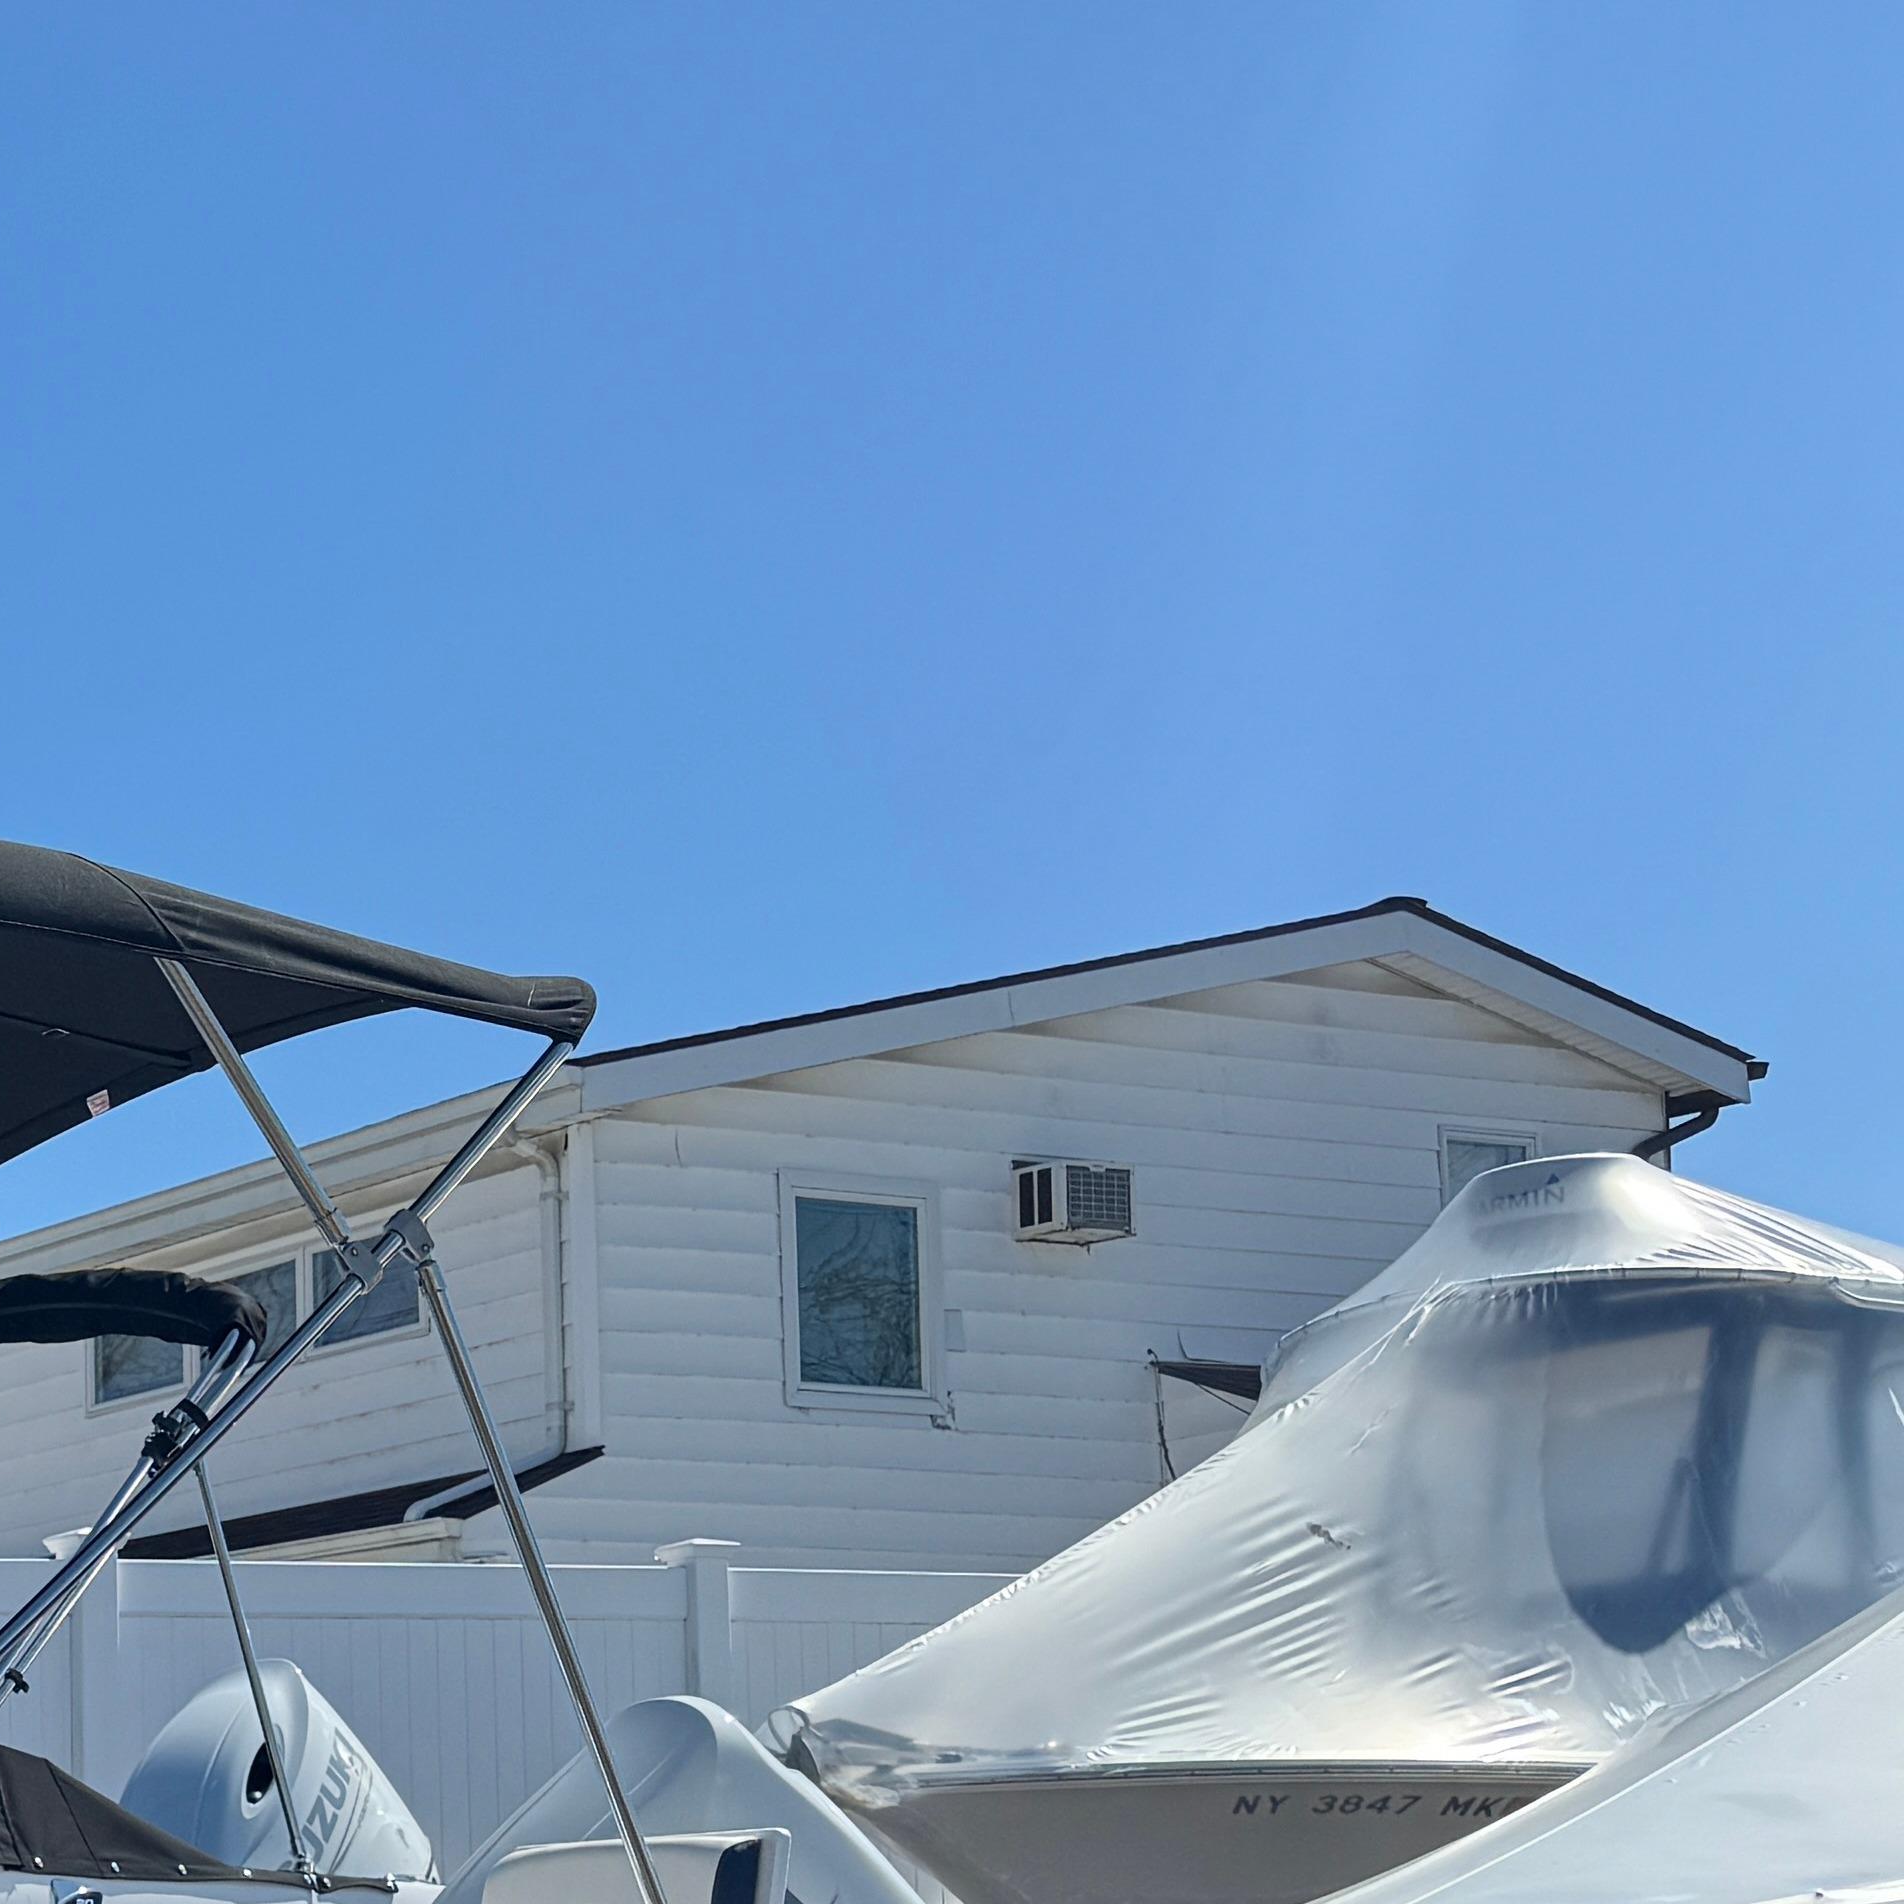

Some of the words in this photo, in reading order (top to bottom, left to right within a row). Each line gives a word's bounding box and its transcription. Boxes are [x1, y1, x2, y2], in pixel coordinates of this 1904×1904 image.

[1476, 1186, 1566, 1215] ARMIN
[1233, 1795, 1289, 1815] NY
[1312, 1795, 1423, 1815] 3847
[1440, 1796, 1505, 1817] MK
